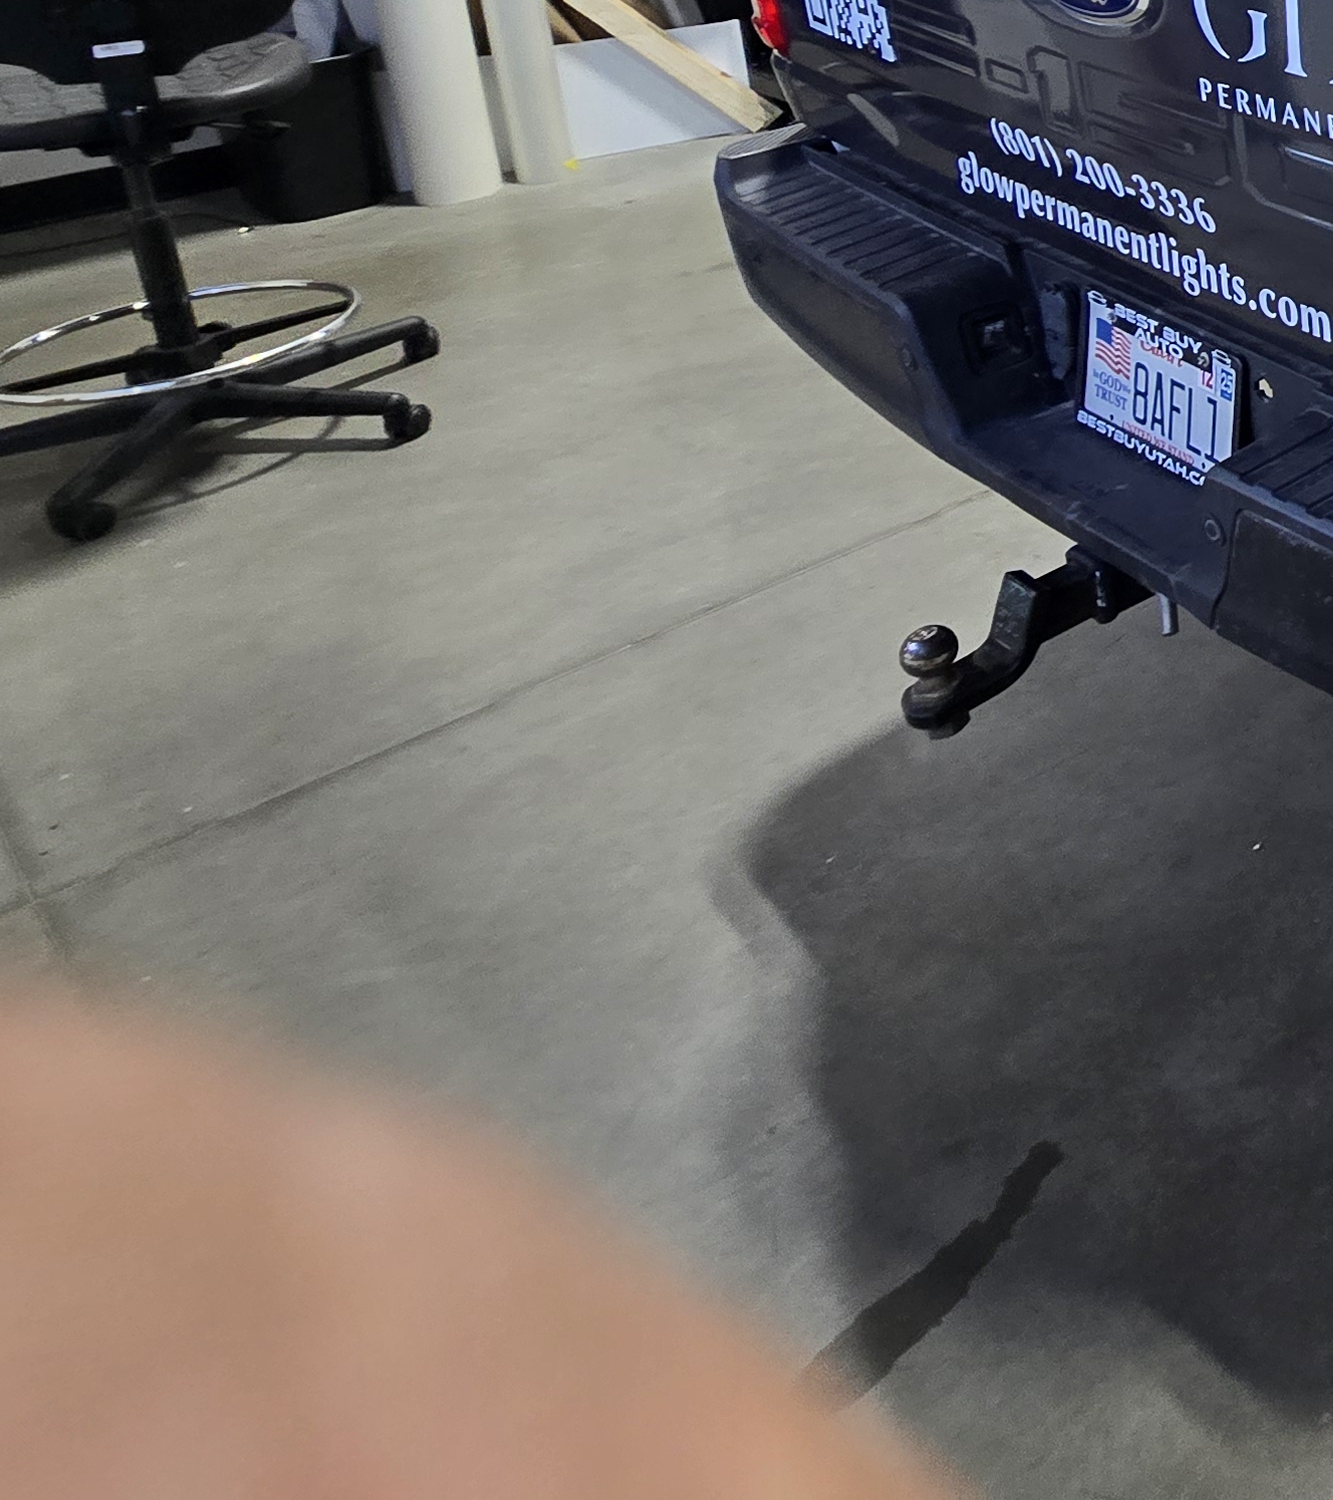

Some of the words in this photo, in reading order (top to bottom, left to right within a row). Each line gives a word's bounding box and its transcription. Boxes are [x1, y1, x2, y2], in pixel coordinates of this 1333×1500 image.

[990, 117, 1063, 177] (801)
[1066, 148, 1217, 233] 200-3336
[957, 151, 1333, 342] glowpermanentlights.com
[1113, 303, 1159, 333] BEST
[1163, 326, 1203, 354] BUY
[1133, 327, 1184, 360] AUTO
[1094, 385, 1128, 411] TRUST
[1099, 371, 1122, 392] GOD
